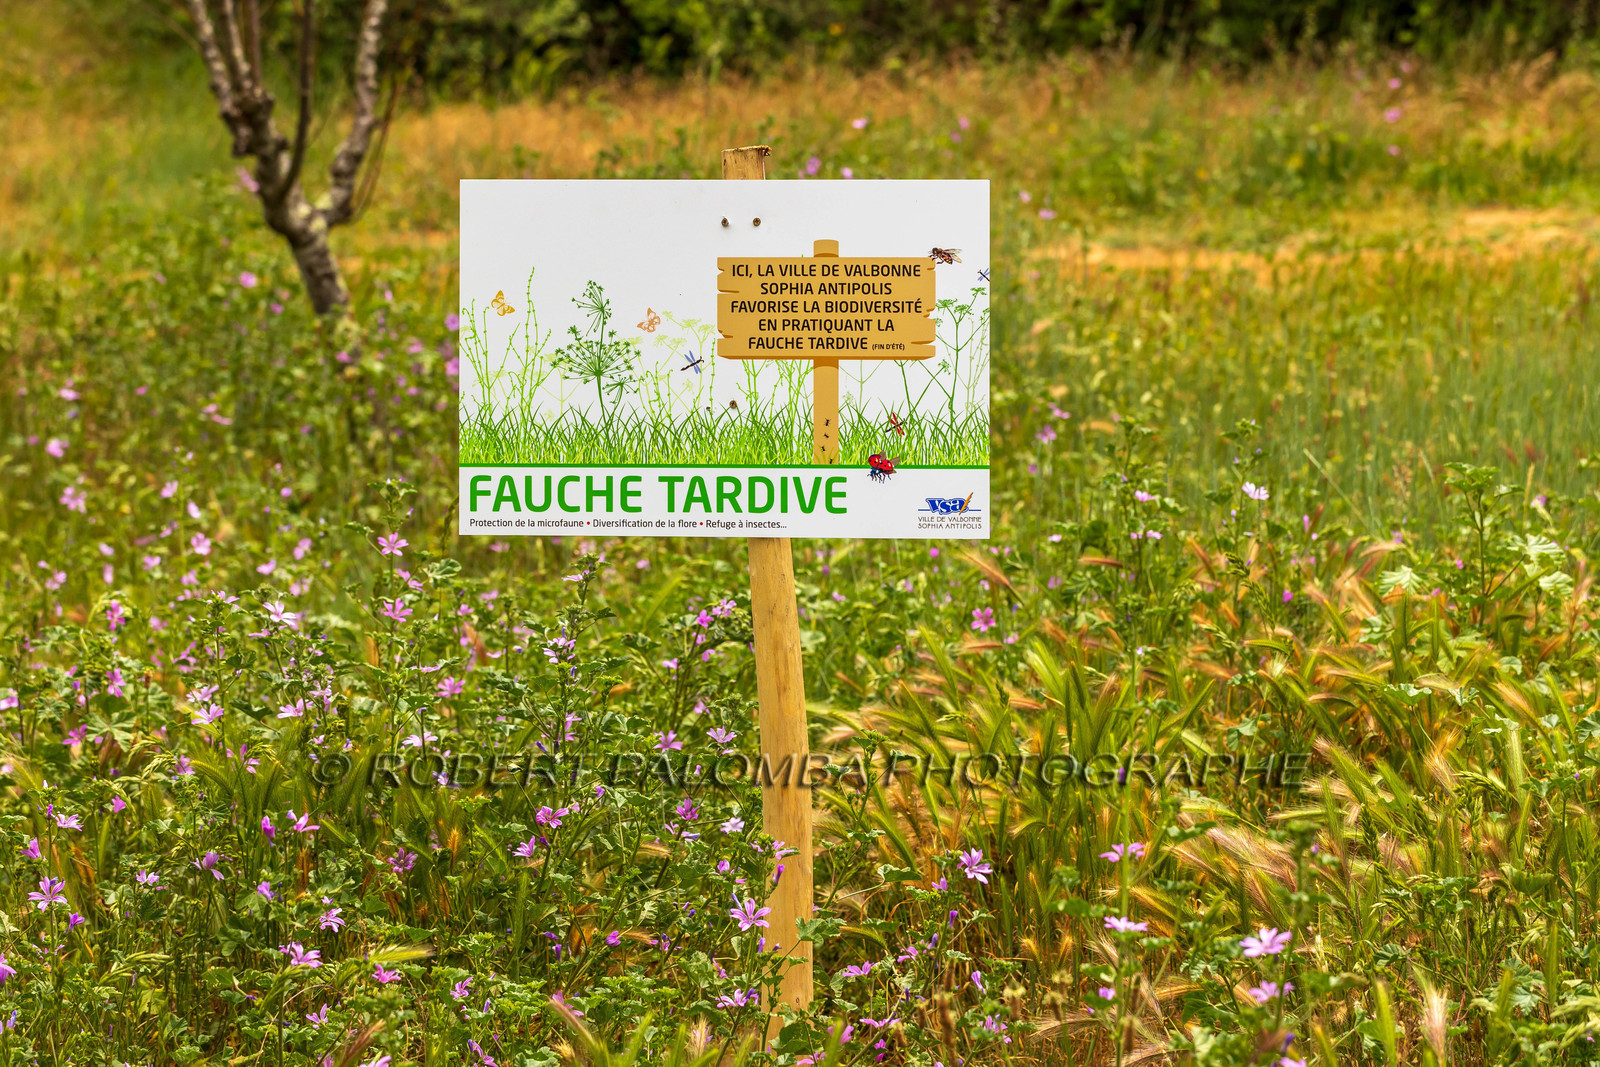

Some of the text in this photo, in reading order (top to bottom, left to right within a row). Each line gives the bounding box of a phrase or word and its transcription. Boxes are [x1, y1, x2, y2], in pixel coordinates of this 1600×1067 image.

[732, 264, 921, 278] ICI, LA VILLE DE VALBONNE
[760, 282, 892, 295] SOPHIA ANTIPOLIS
[730, 298, 922, 314] FAVORISE LA BIODIVERSITÉ
[758, 318, 895, 334] EN PRATIQUANT LA
[748, 336, 804, 350] FAUCHE
[808, 337, 868, 350] TARDIVE
[886, 342, 905, 350] D'ÉTÉ)
[470, 475, 847, 514] FAUCHE TARDIVE
[470, 518, 787, 529] Protection de la microfaune Diversification de la flore Refuge à insectes...
